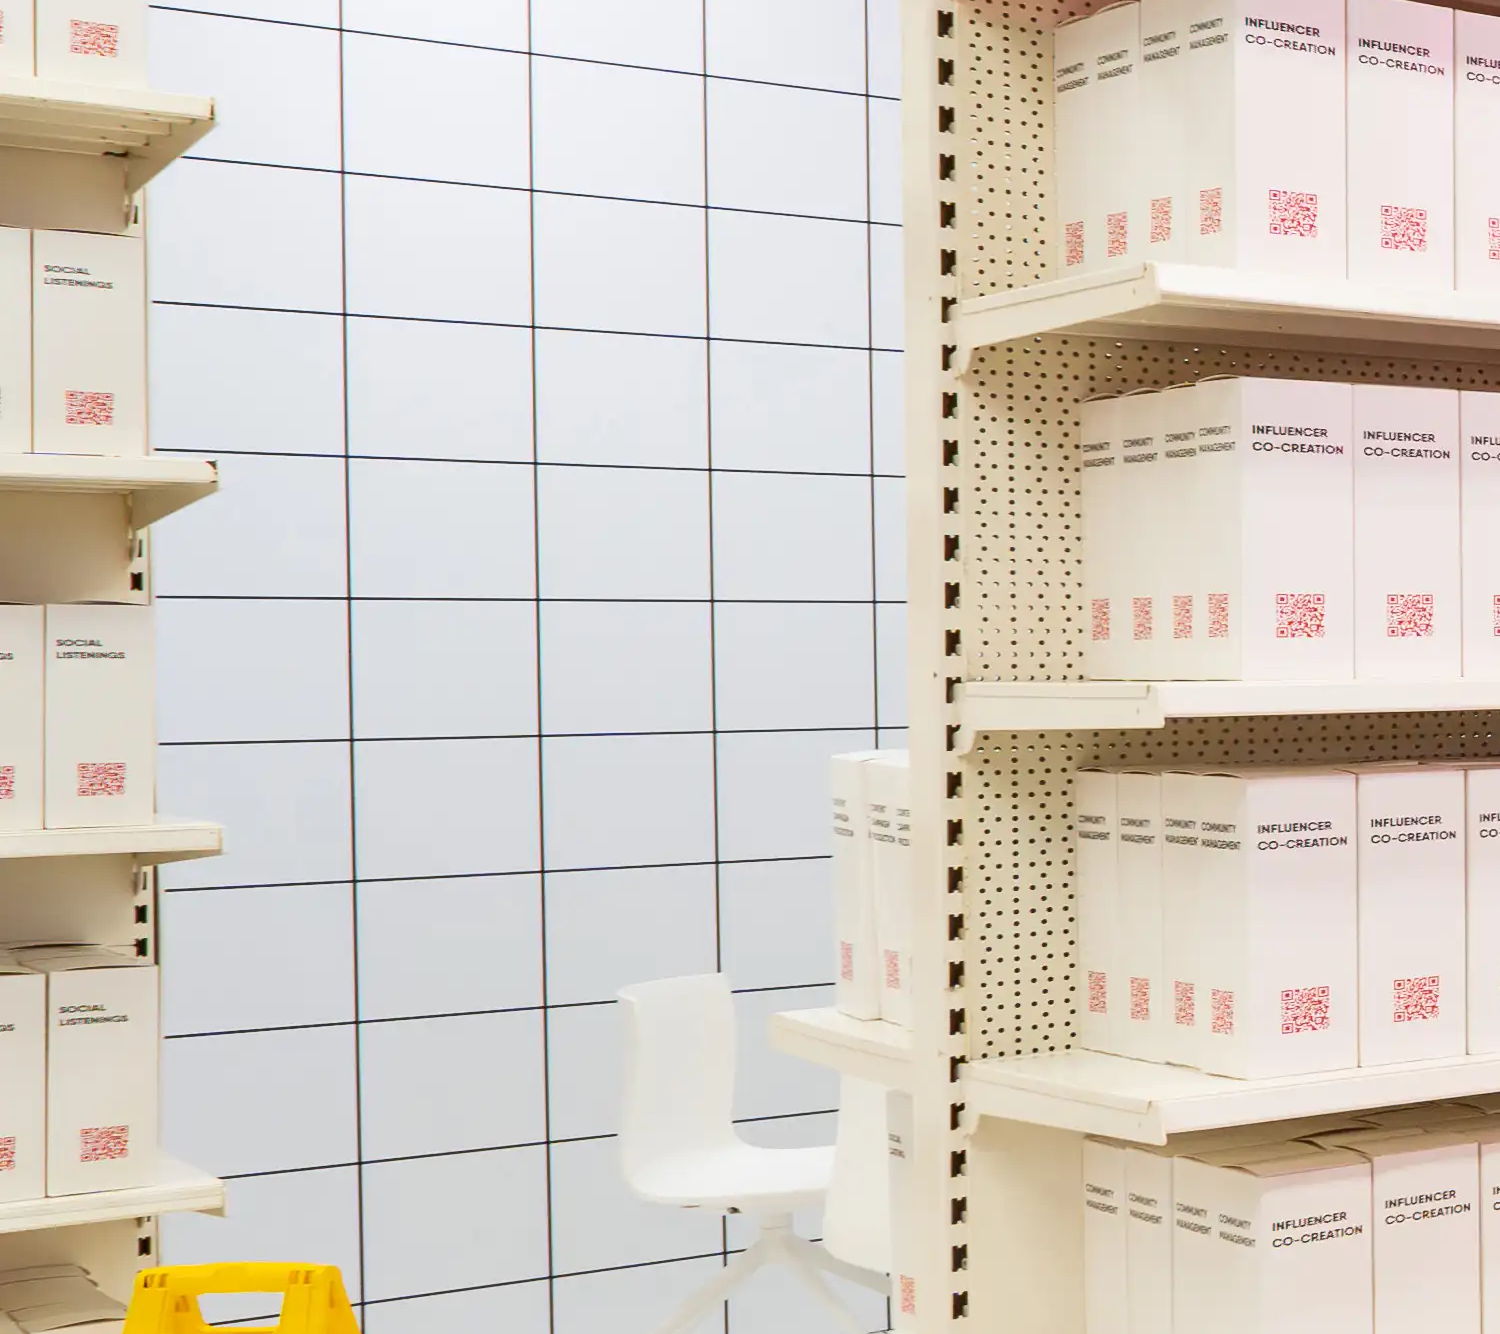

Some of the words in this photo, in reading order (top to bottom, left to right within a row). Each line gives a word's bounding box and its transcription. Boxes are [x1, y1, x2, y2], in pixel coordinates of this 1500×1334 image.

[1244, 16, 1321, 38] INFLUENCER
[1245, 33, 1336, 56] CO-CREATION
[1358, 38, 1431, 58] INFLUENCER
[1358, 54, 1445, 76] CO-CREATION
[43, 264, 92, 276] SOCIAL
[43, 277, 114, 290] LISTENINGS
[1251, 424, 1329, 438] INFLUENCER
[1363, 430, 1436, 443] INFLUENCER
[1251, 441, 1344, 455] CO-CREATION
[1363, 446, 1451, 459] CO-CREATION
[55, 638, 104, 648] SOCIAL
[55, 651, 126, 660] LISTENINGS
[1257, 820, 1333, 835] INFLUENCER
[1257, 836, 1348, 851] CO-CREATION
[58, 1004, 108, 1014] SOCIAL
[58, 1014, 129, 1027] LISTENINGS
[1272, 1211, 1347, 1232] INFLUENCER
[1271, 1224, 1363, 1249] CO-CREATION
